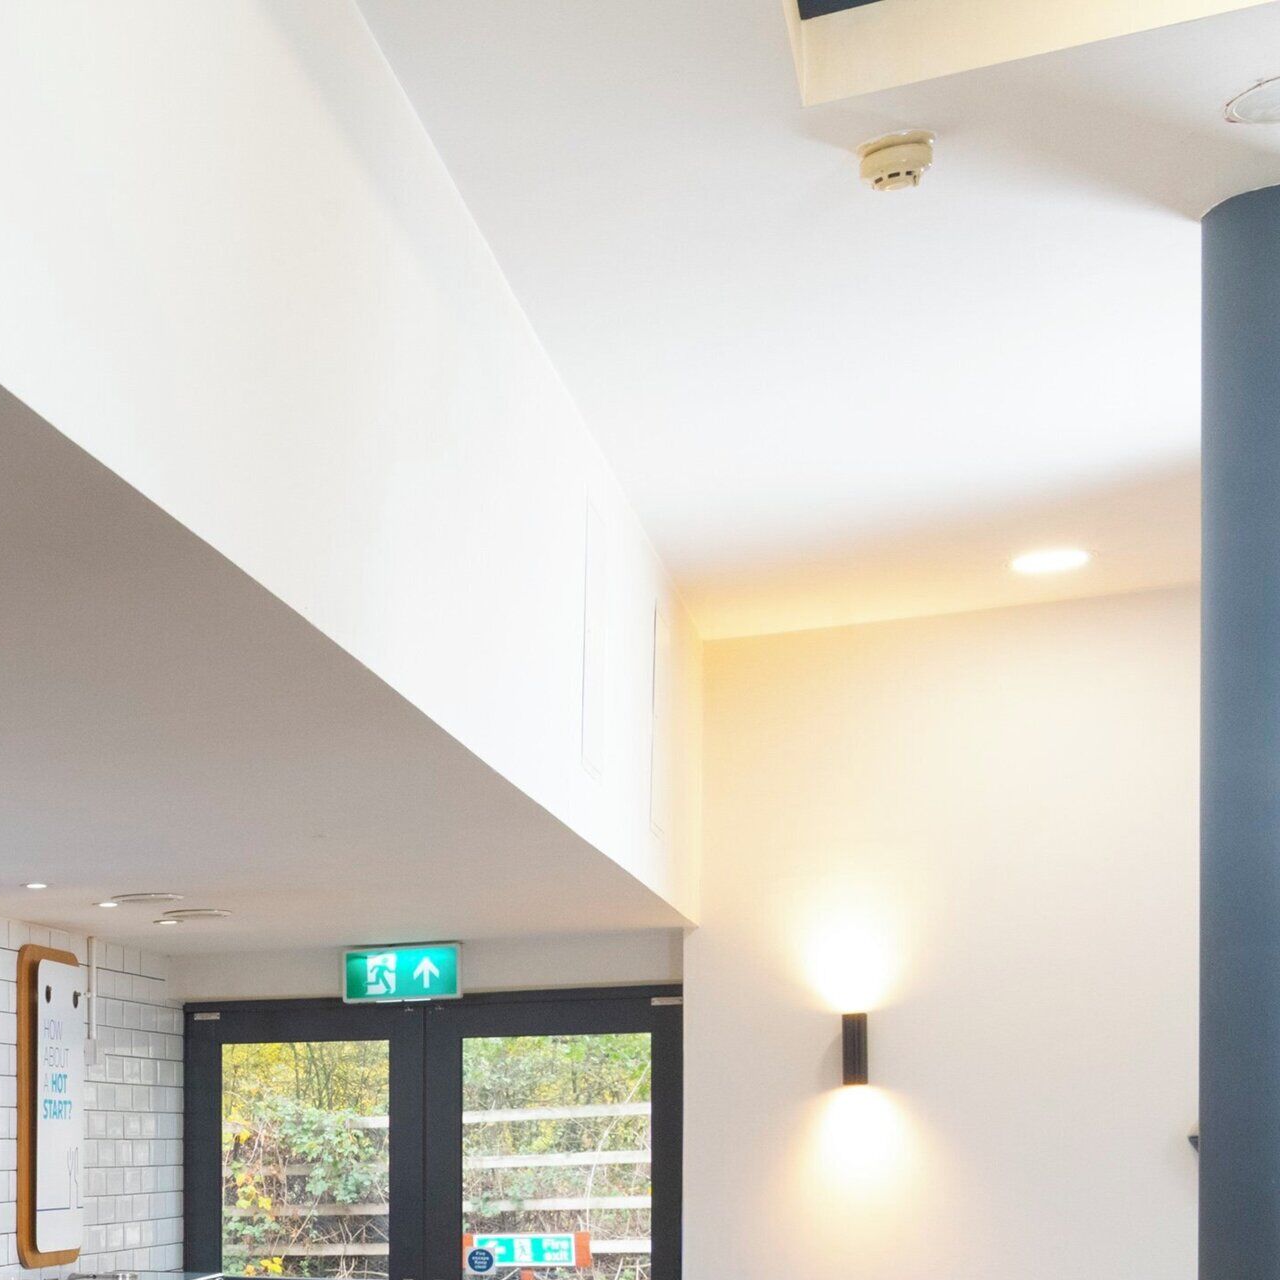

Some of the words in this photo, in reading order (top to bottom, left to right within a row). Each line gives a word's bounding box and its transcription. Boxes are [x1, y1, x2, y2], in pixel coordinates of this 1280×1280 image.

[44, 1018, 63, 1040] HOW
[44, 1046, 69, 1069] ABOUT
[44, 1073, 49, 1094] A
[51, 1073, 68, 1093] HOT
[43, 1099, 72, 1120] START?
[542, 1239, 569, 1250] Fire
[544, 1250, 569, 1261] exit
